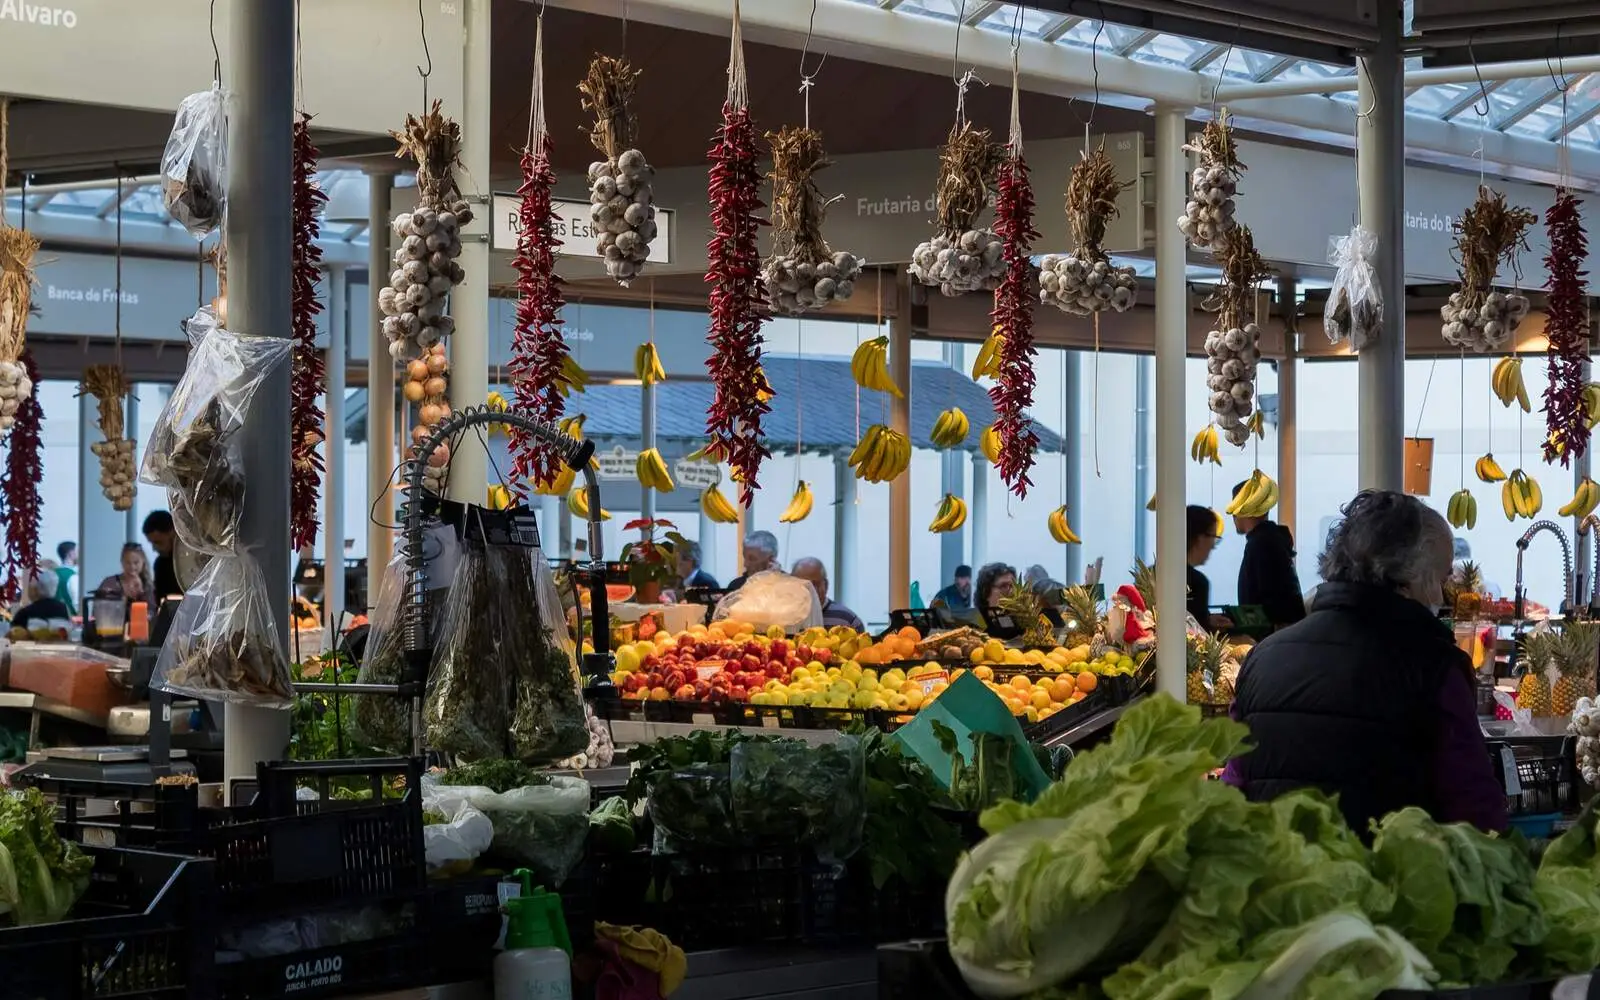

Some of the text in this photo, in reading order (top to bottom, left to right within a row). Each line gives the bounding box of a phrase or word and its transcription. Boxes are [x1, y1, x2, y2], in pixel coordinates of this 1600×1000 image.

[857, 196, 921, 216] Frutaria
[571, 218, 598, 238] Est
[1405, 211, 1429, 230] taria
[1430, 213, 1444, 232] do
[48, 285, 139, 305] Banca de Frutas
[285, 955, 343, 980] CALADO
